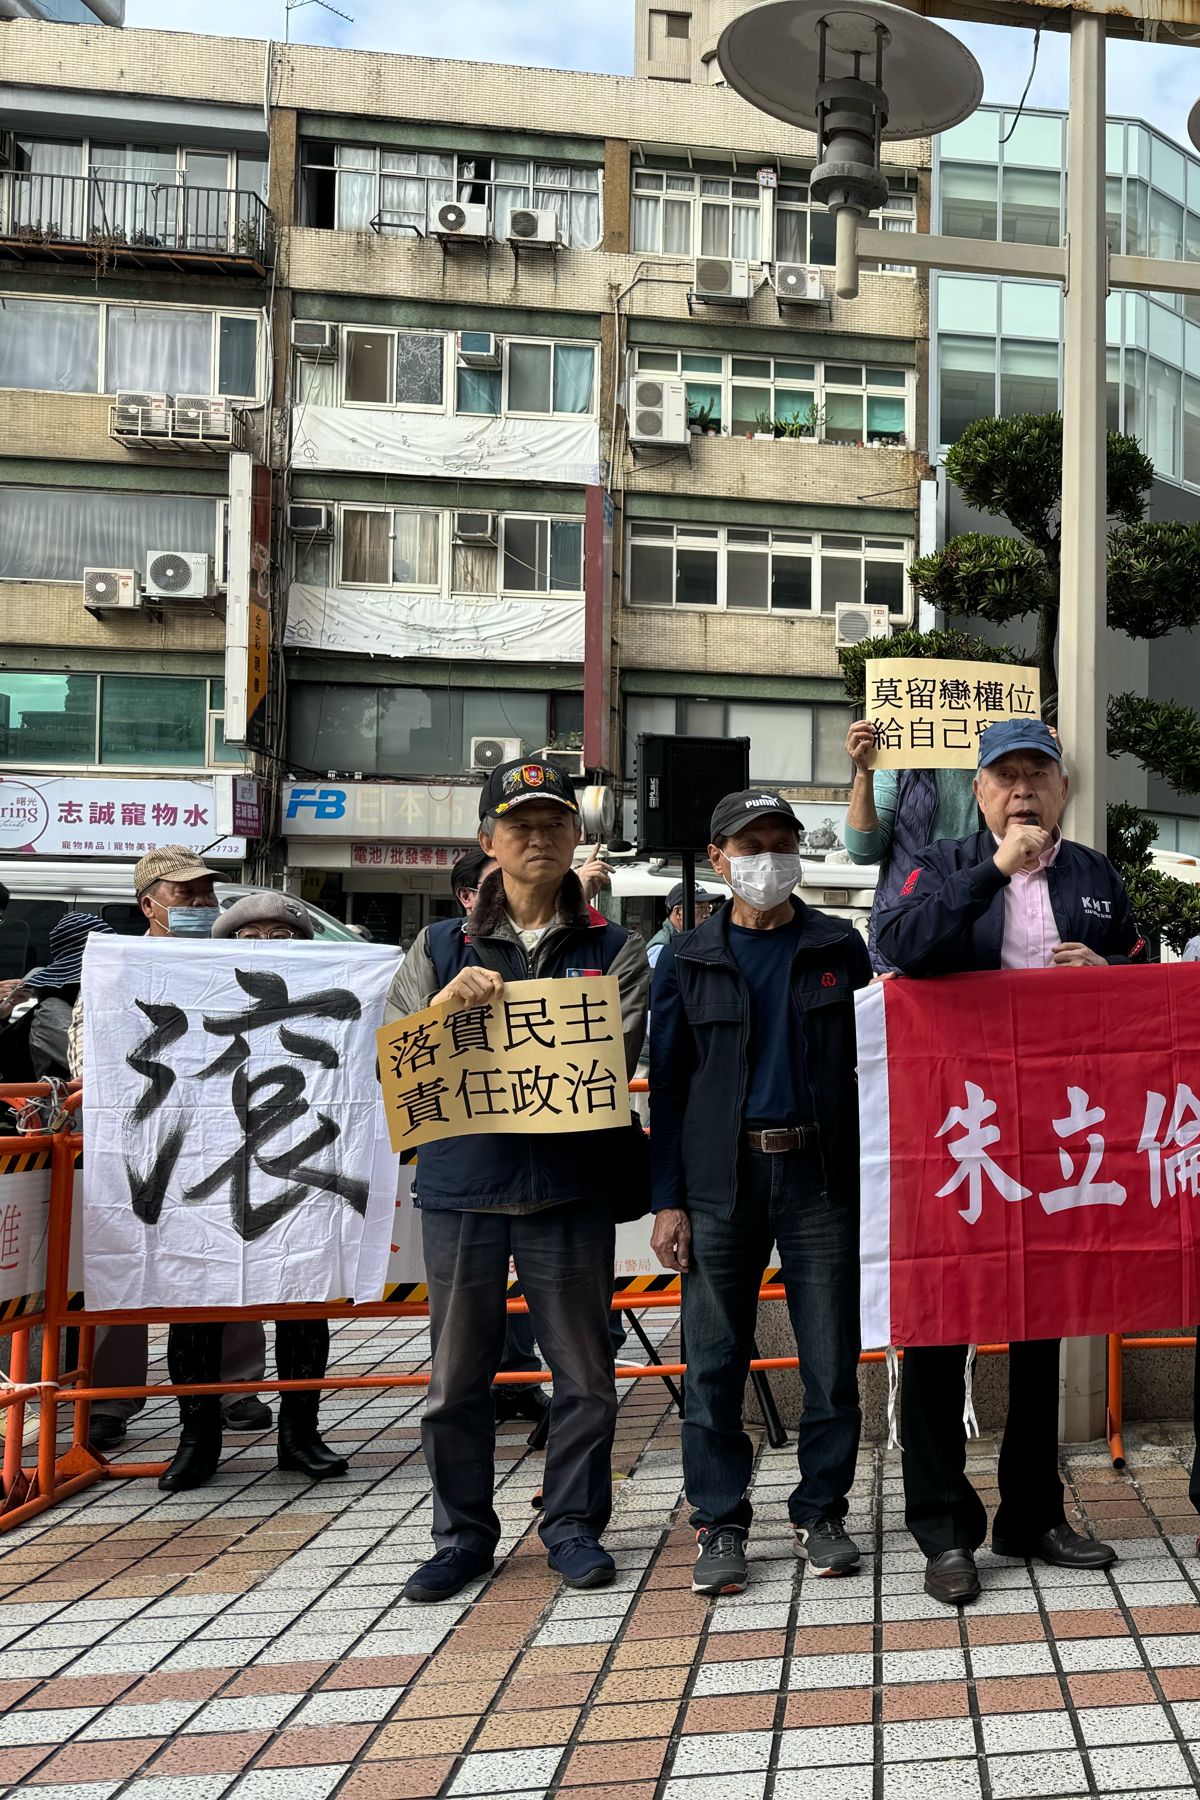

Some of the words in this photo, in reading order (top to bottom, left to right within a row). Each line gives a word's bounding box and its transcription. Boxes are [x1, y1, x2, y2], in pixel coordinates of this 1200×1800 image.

[871, 677, 1037, 715] 莫留戀權位
[57, 800, 209, 827] 志誠寵物水
[286, 789, 347, 819] FB
[745, 798, 778, 809] PUMA
[1081, 896, 1111, 913] KMT
[388, 993, 614, 1079] 落實民主
[396, 1059, 617, 1137] 責任政治
